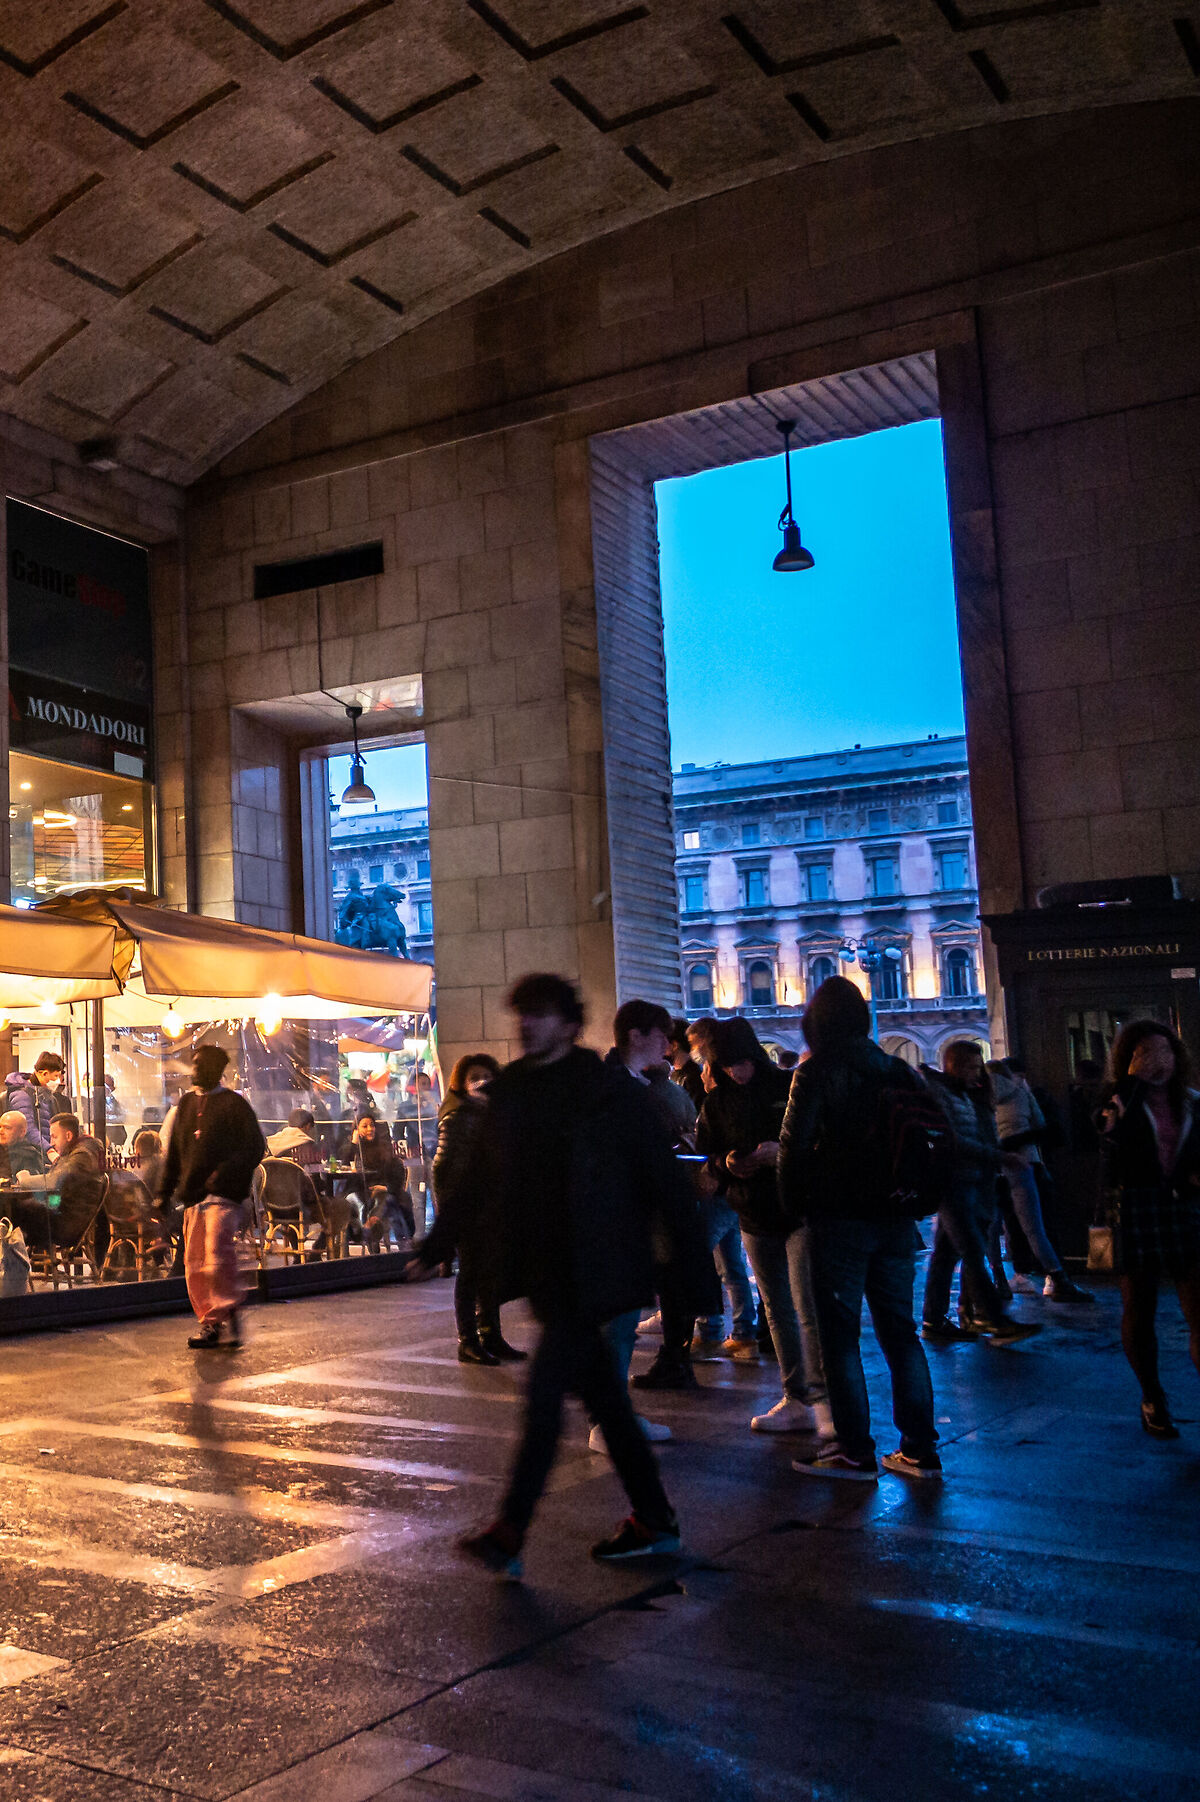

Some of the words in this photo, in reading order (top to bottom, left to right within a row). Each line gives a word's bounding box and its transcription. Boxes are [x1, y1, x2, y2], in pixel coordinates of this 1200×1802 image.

[25, 695, 146, 746] MONDADORI
[1027, 948, 1096, 961] LOTTERIE
[1100, 943, 1180, 958] NAZIONALI
